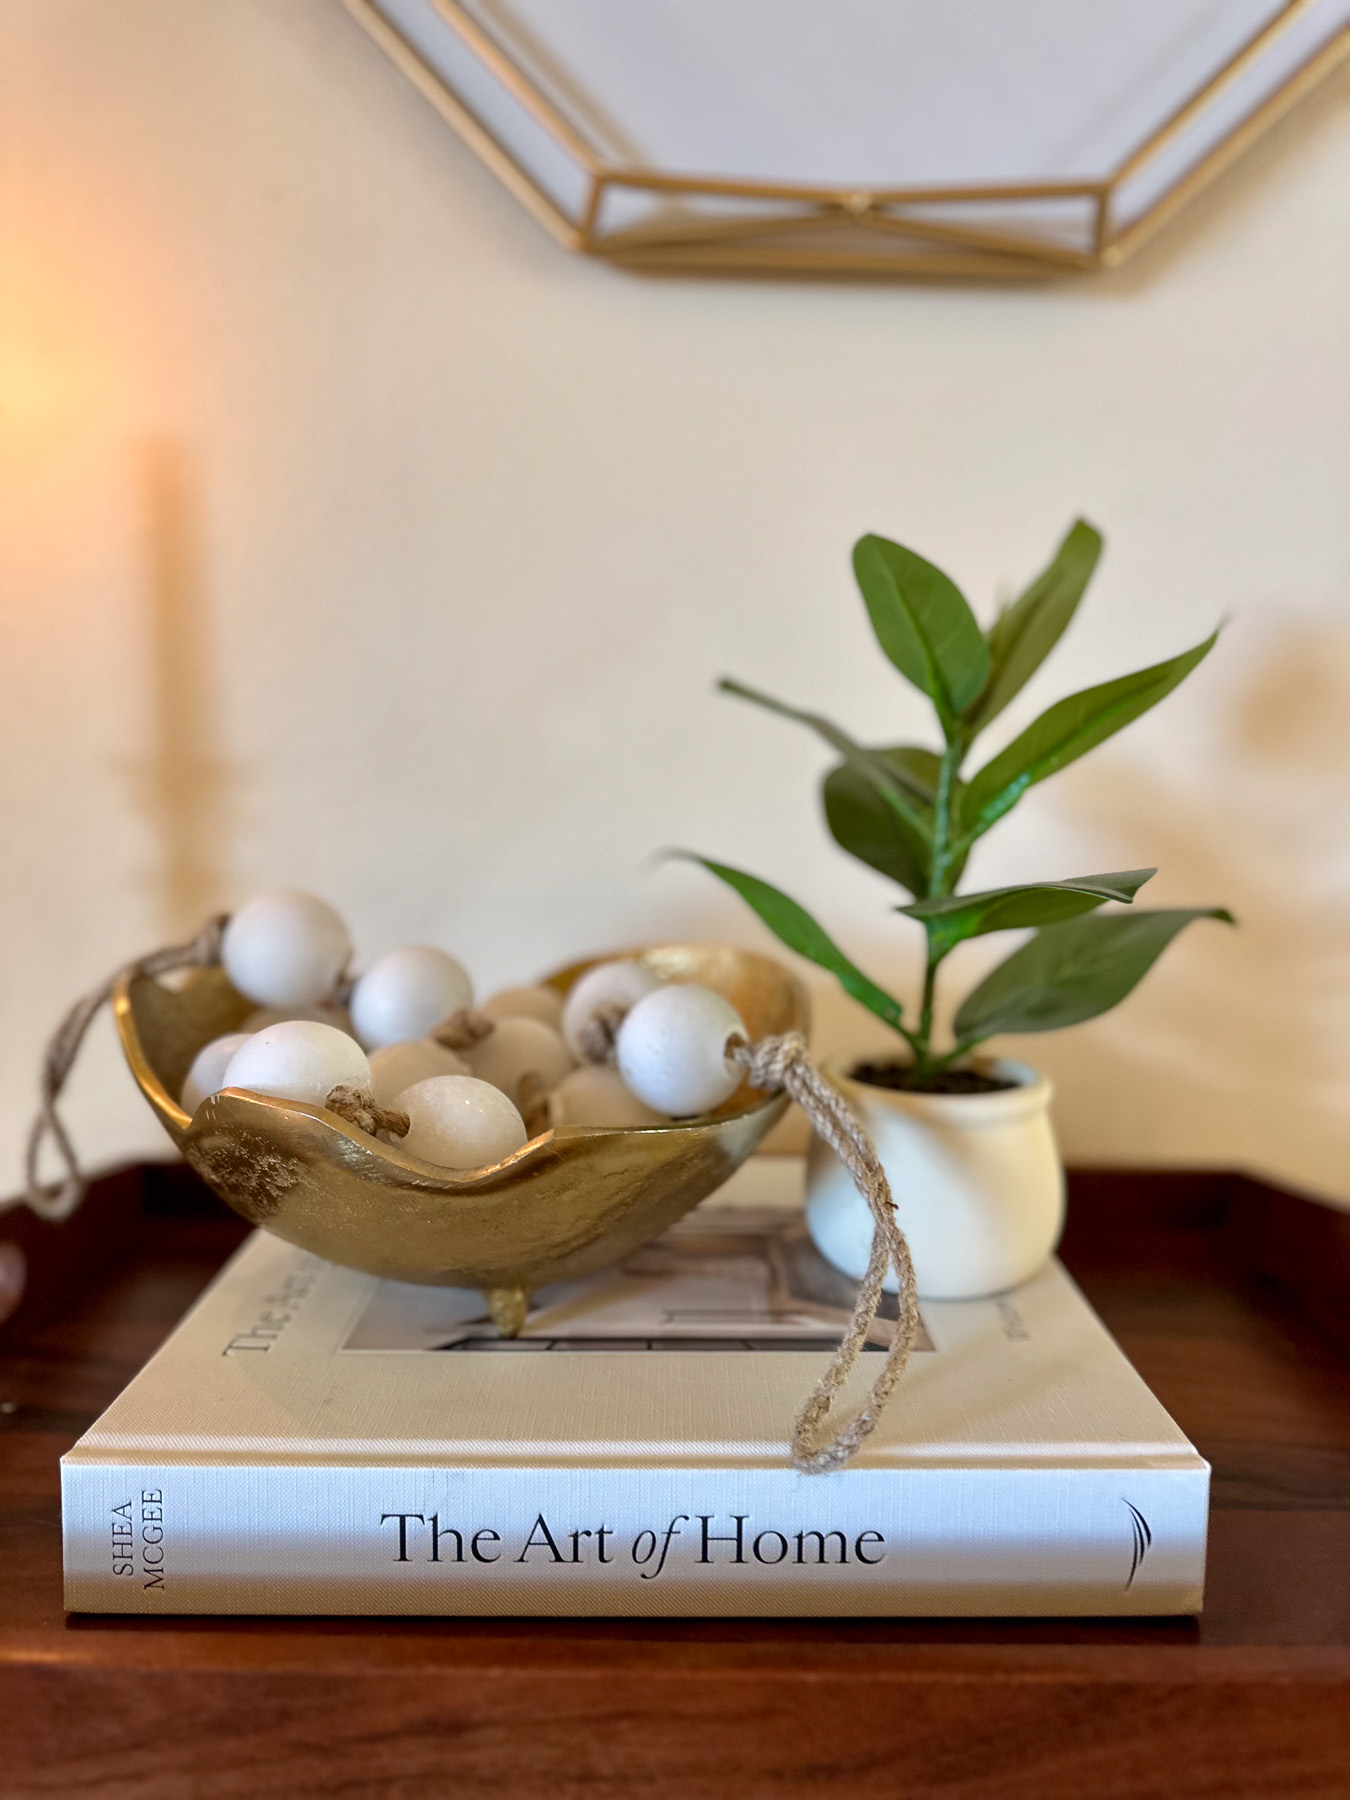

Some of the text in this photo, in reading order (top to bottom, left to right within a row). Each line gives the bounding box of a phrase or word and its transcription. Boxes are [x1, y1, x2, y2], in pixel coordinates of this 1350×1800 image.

[111, 1500, 134, 1577] SHEA
[141, 1488, 165, 1591] MCGEE
[380, 1513, 886, 1580] The Art of Home
